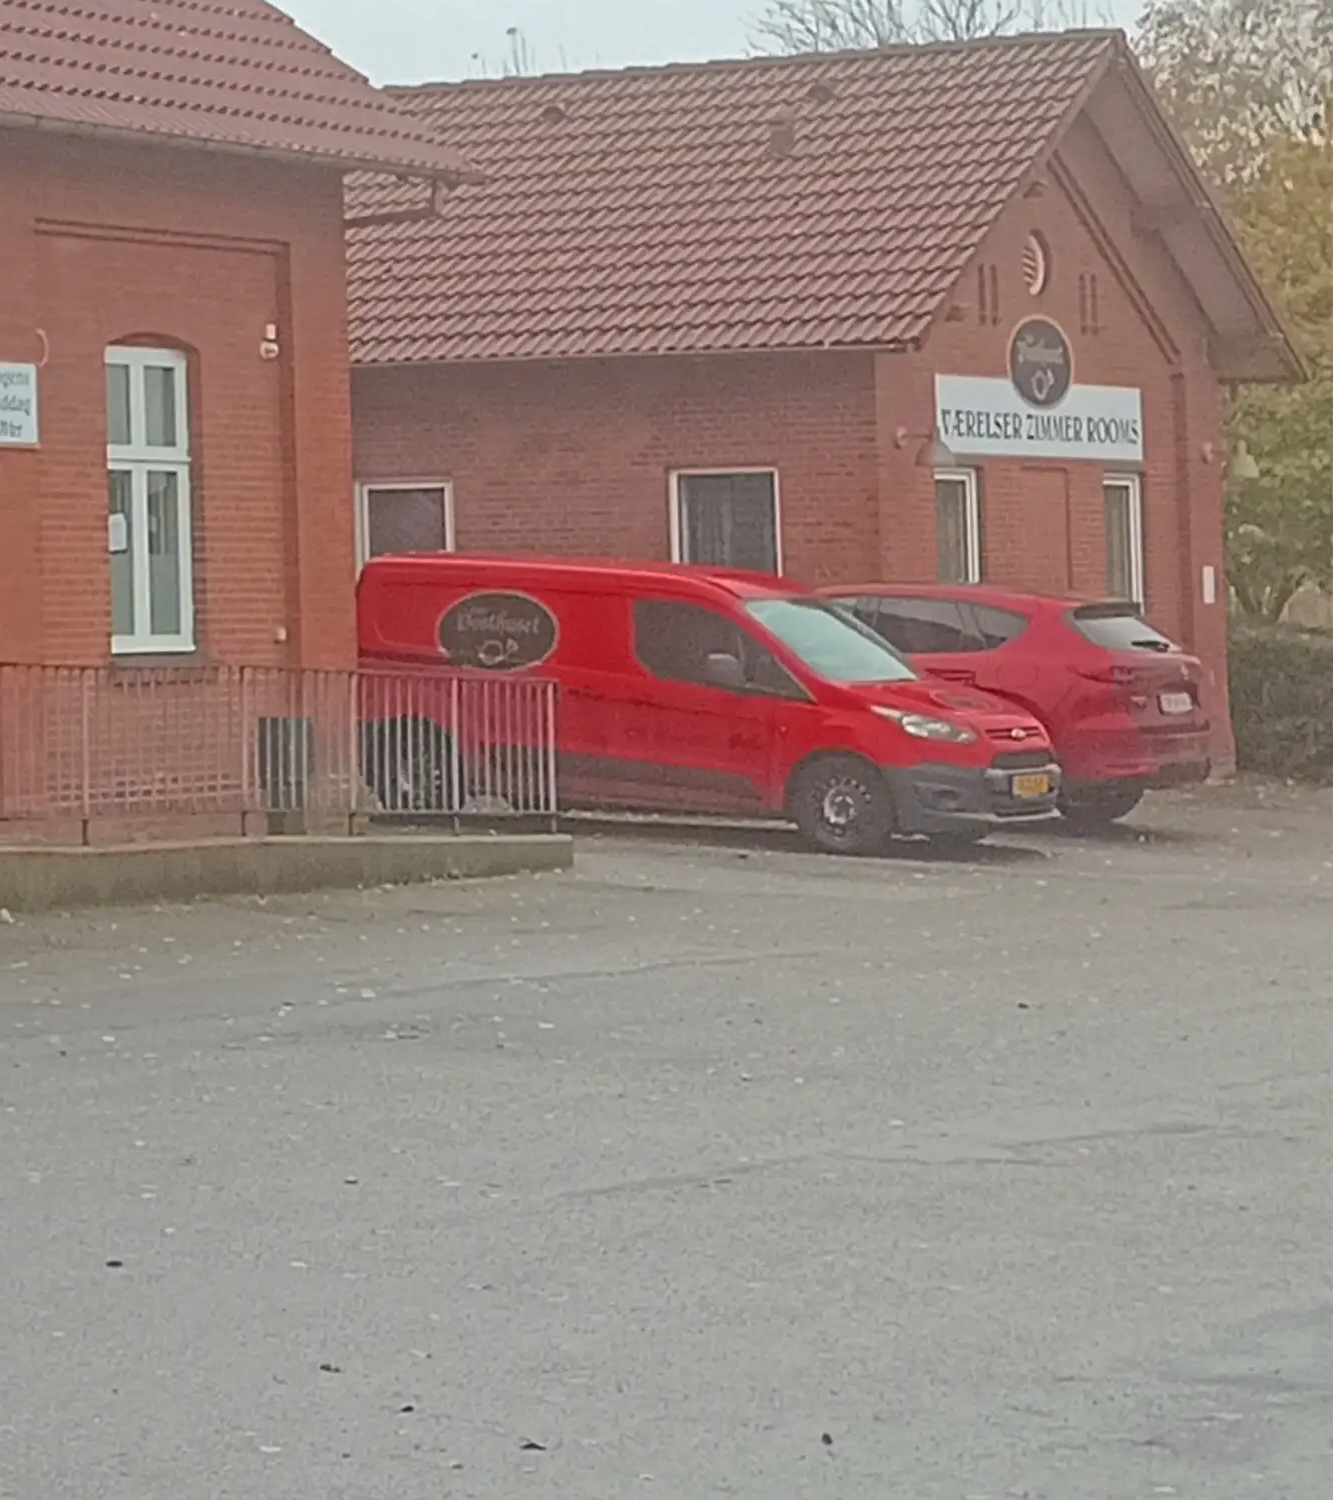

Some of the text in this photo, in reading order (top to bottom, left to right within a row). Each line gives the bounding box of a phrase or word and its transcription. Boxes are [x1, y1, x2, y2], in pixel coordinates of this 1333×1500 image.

[941, 408, 1139, 445] VÆRELSER ZIMMER ROOMS
